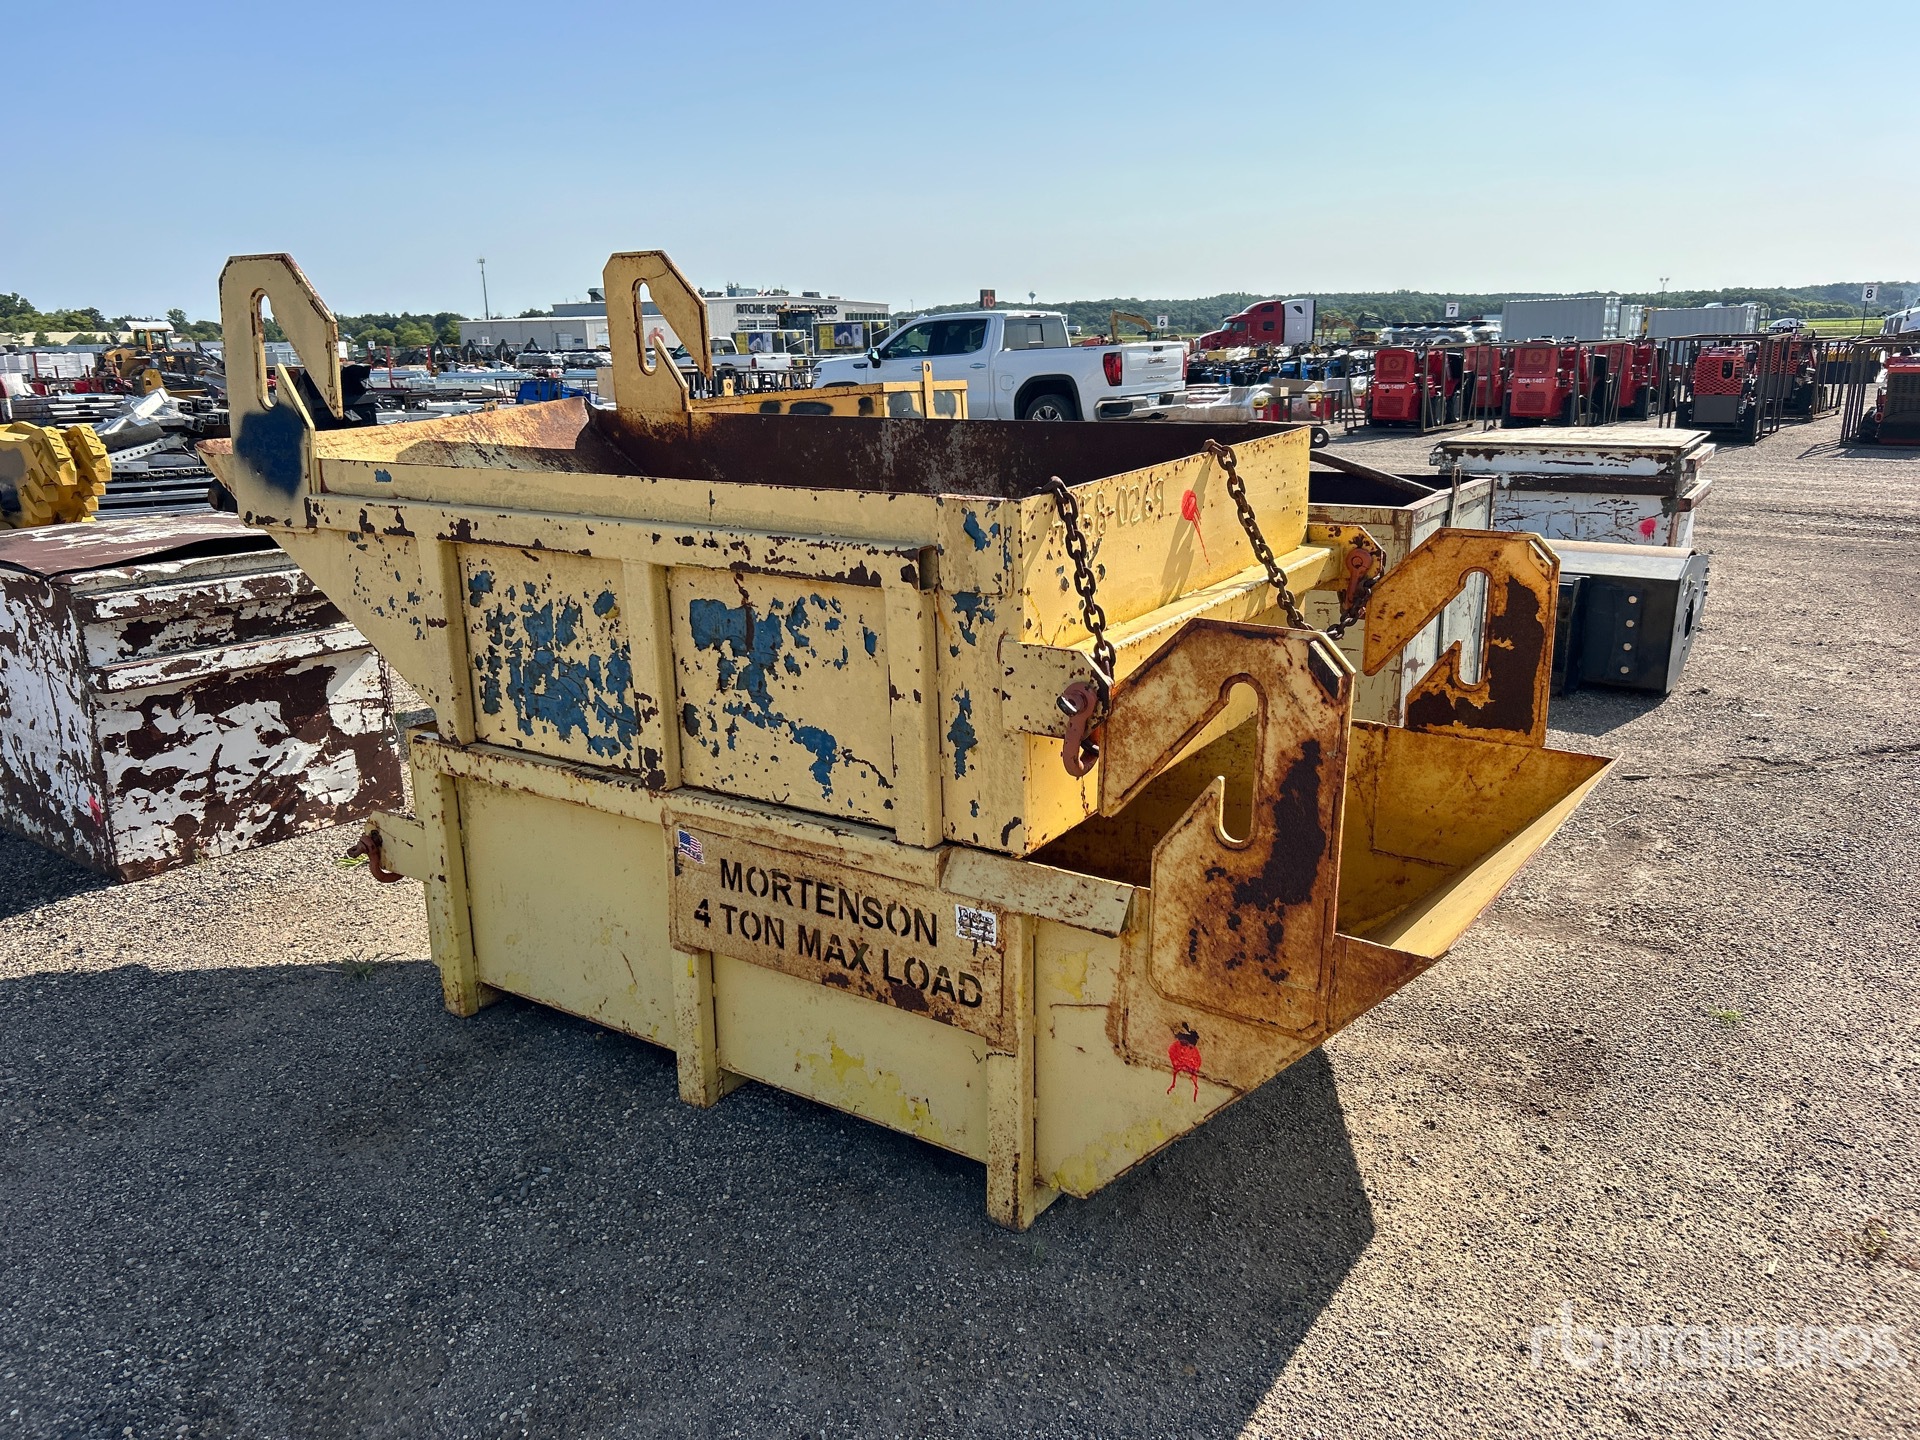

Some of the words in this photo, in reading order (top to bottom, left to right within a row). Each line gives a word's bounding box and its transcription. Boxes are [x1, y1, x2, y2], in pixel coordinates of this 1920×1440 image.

[1865, 288, 1873, 299] 8
[736, 304, 765, 314] RITCHIE
[1449, 306, 1456, 315] 7
[1159, 319, 1166, 327] 6
[719, 857, 938, 948] MORTENSON
[693, 898, 712, 928] 4
[719, 903, 785, 949] TON
[797, 924, 871, 975] MAX
[882, 948, 984, 1009] LOAD
